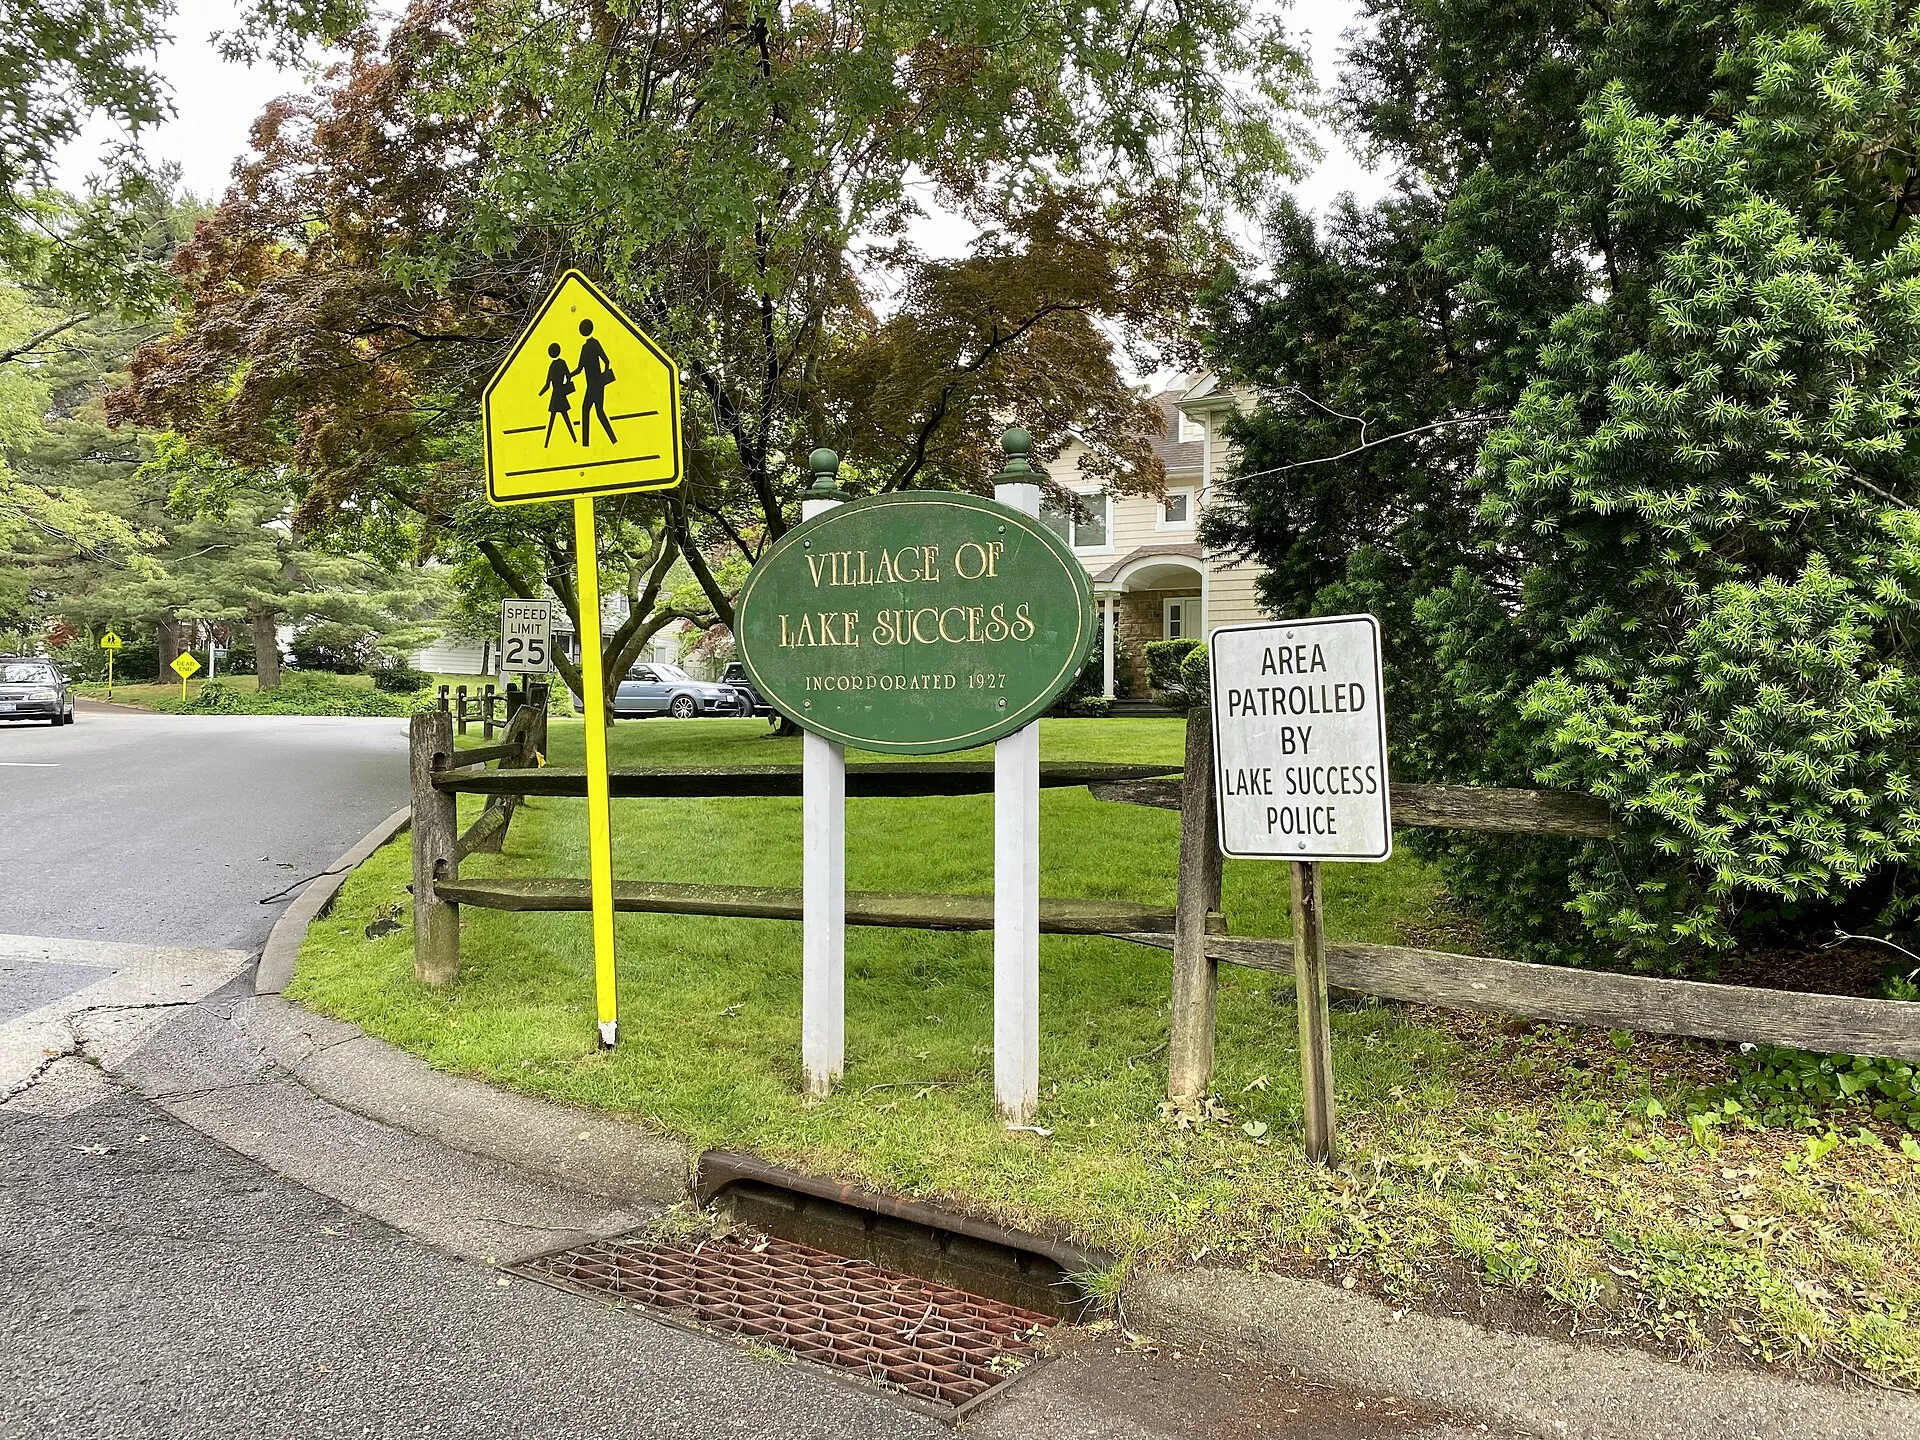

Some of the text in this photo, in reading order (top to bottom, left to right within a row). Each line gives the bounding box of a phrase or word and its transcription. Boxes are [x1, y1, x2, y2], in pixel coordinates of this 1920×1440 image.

[805, 539, 1005, 587] VILLAGE OF
[507, 608, 547, 620] SPEED
[510, 623, 542, 635] LIMIT
[778, 601, 1036, 649] LAKE SUCCESS
[506, 637, 545, 665] 25
[1261, 643, 1327, 676] AREA
[805, 673, 1007, 691] INCORPORATED 1927
[1228, 682, 1366, 717] PATROLLED
[1281, 725, 1312, 755] BY
[1225, 765, 1377, 796] LAKE SUCCESS
[1267, 806, 1337, 835] POLICE
